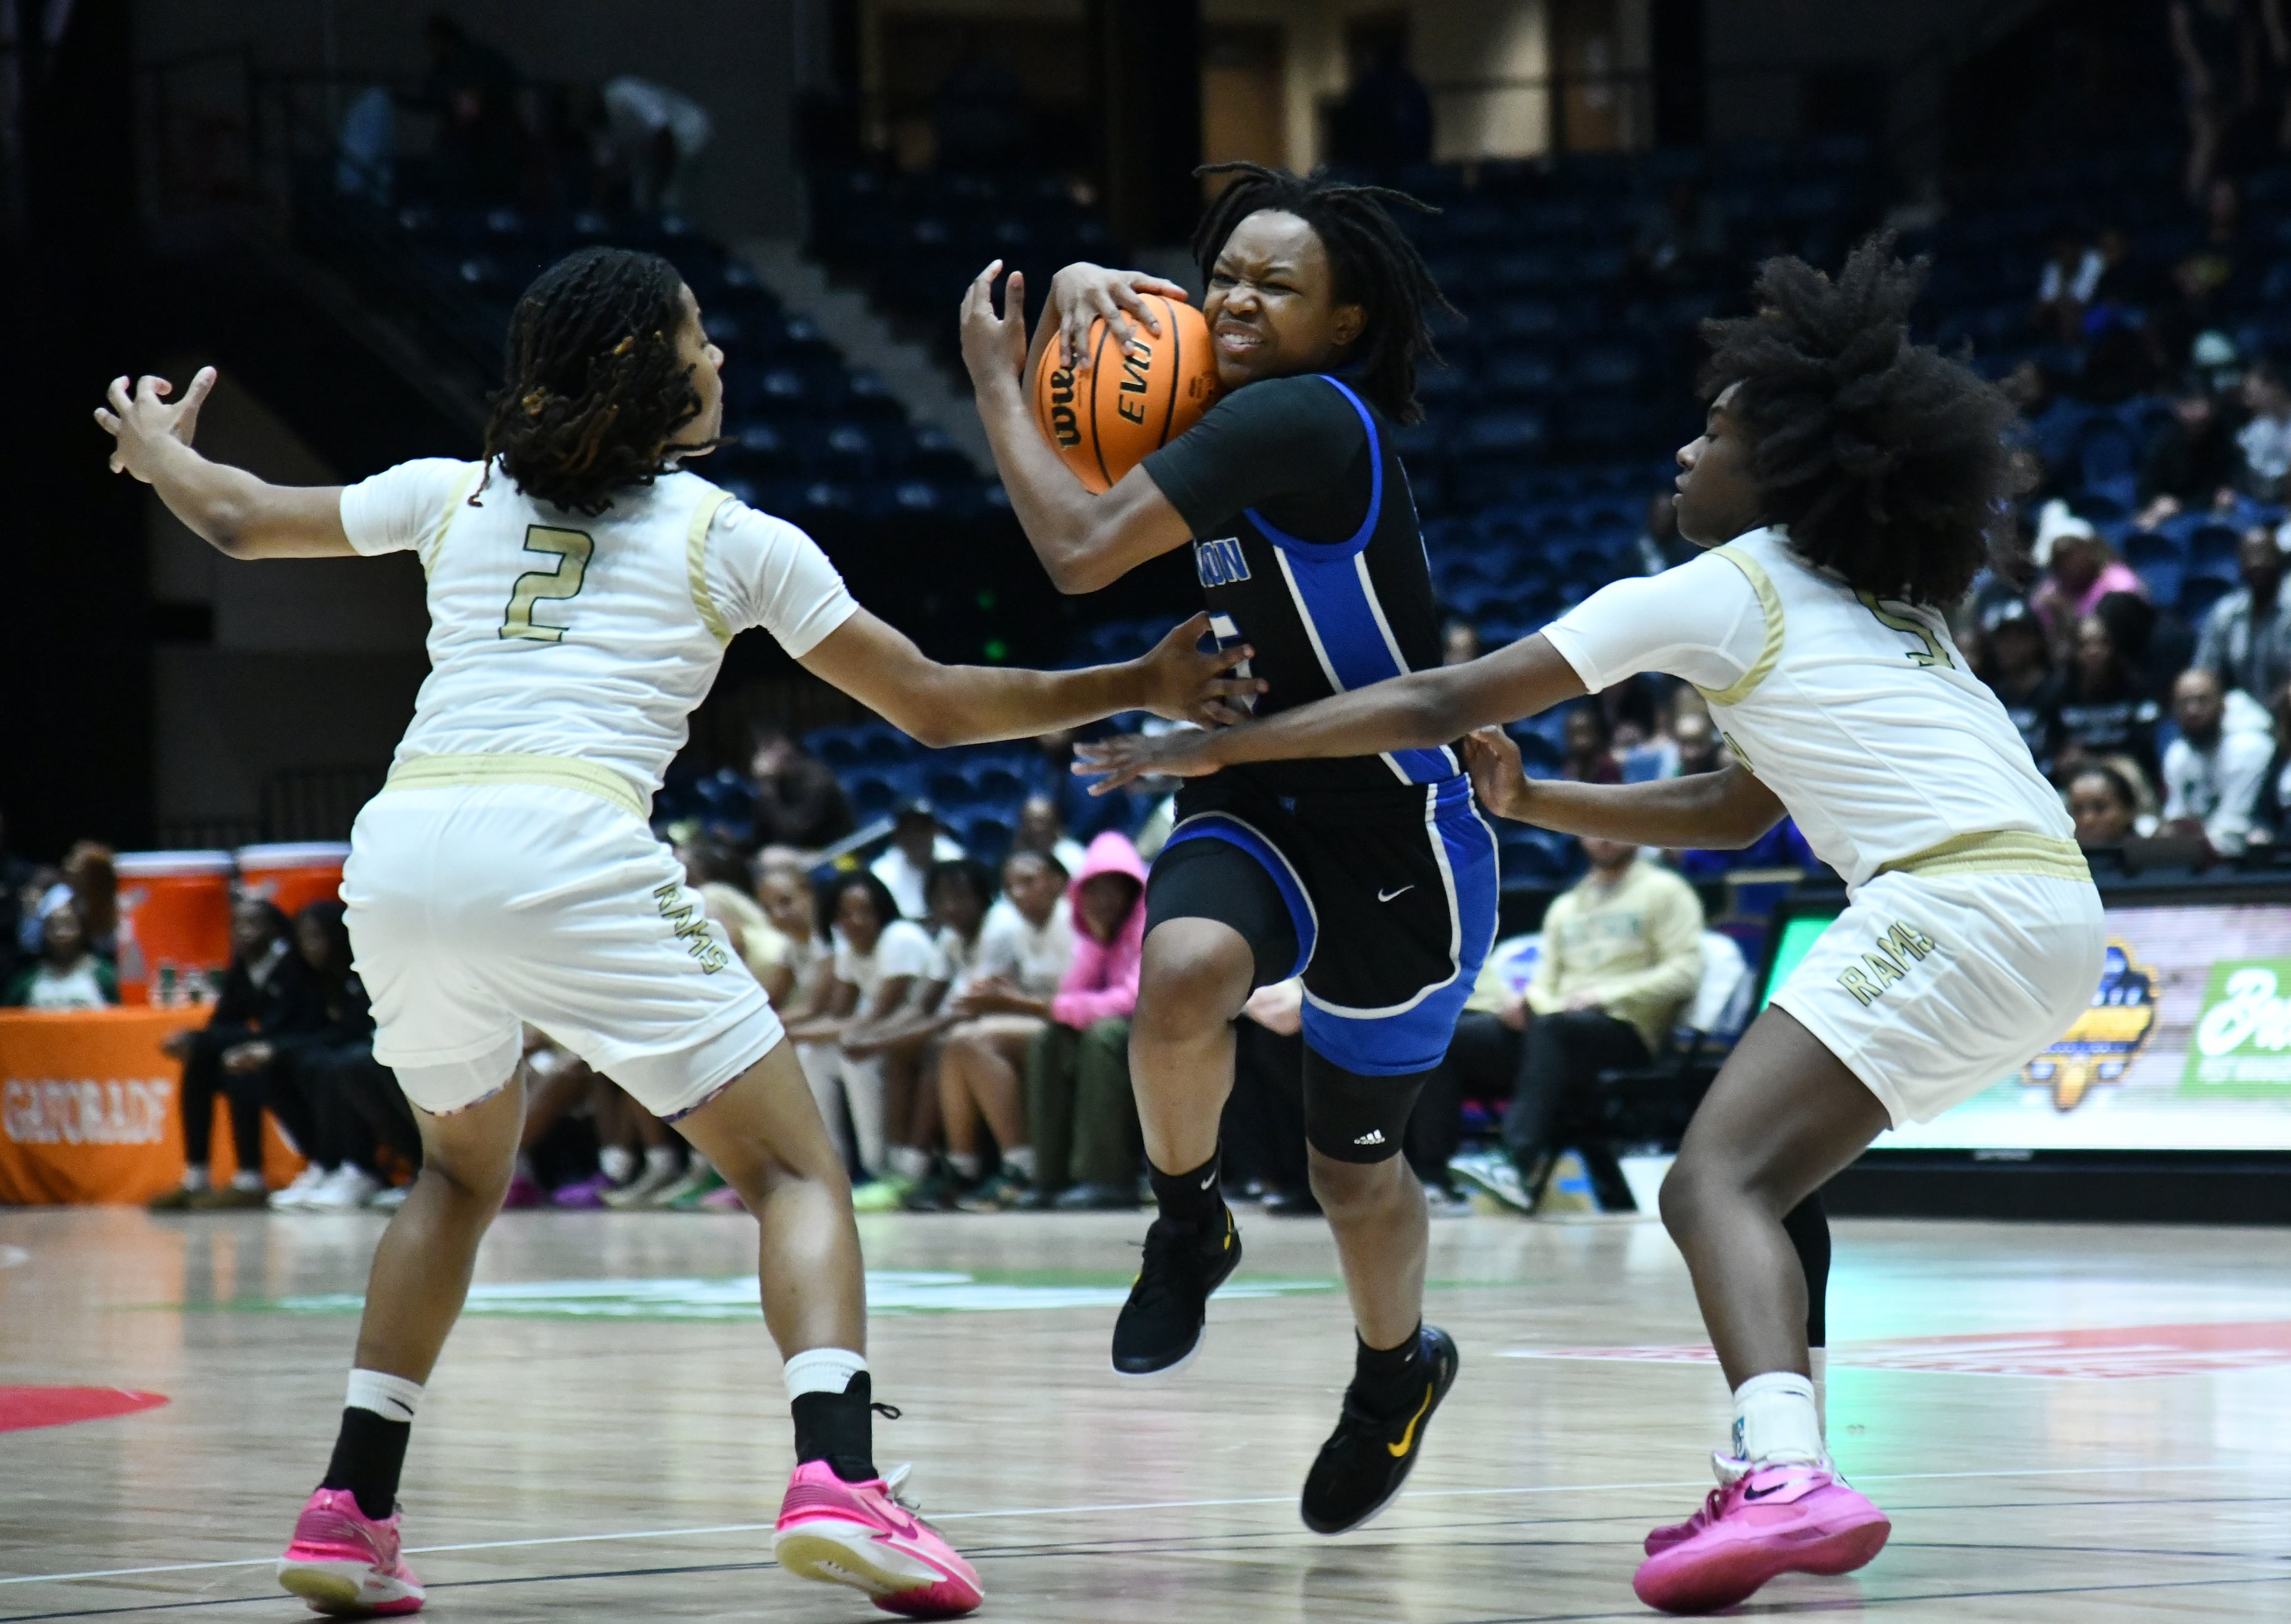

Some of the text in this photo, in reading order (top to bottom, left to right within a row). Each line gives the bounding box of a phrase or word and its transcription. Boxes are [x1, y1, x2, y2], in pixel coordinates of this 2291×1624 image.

[498, 524, 594, 642] 2
[653, 881, 729, 975] RAMS
[1837, 919, 1936, 1007] RAMS
